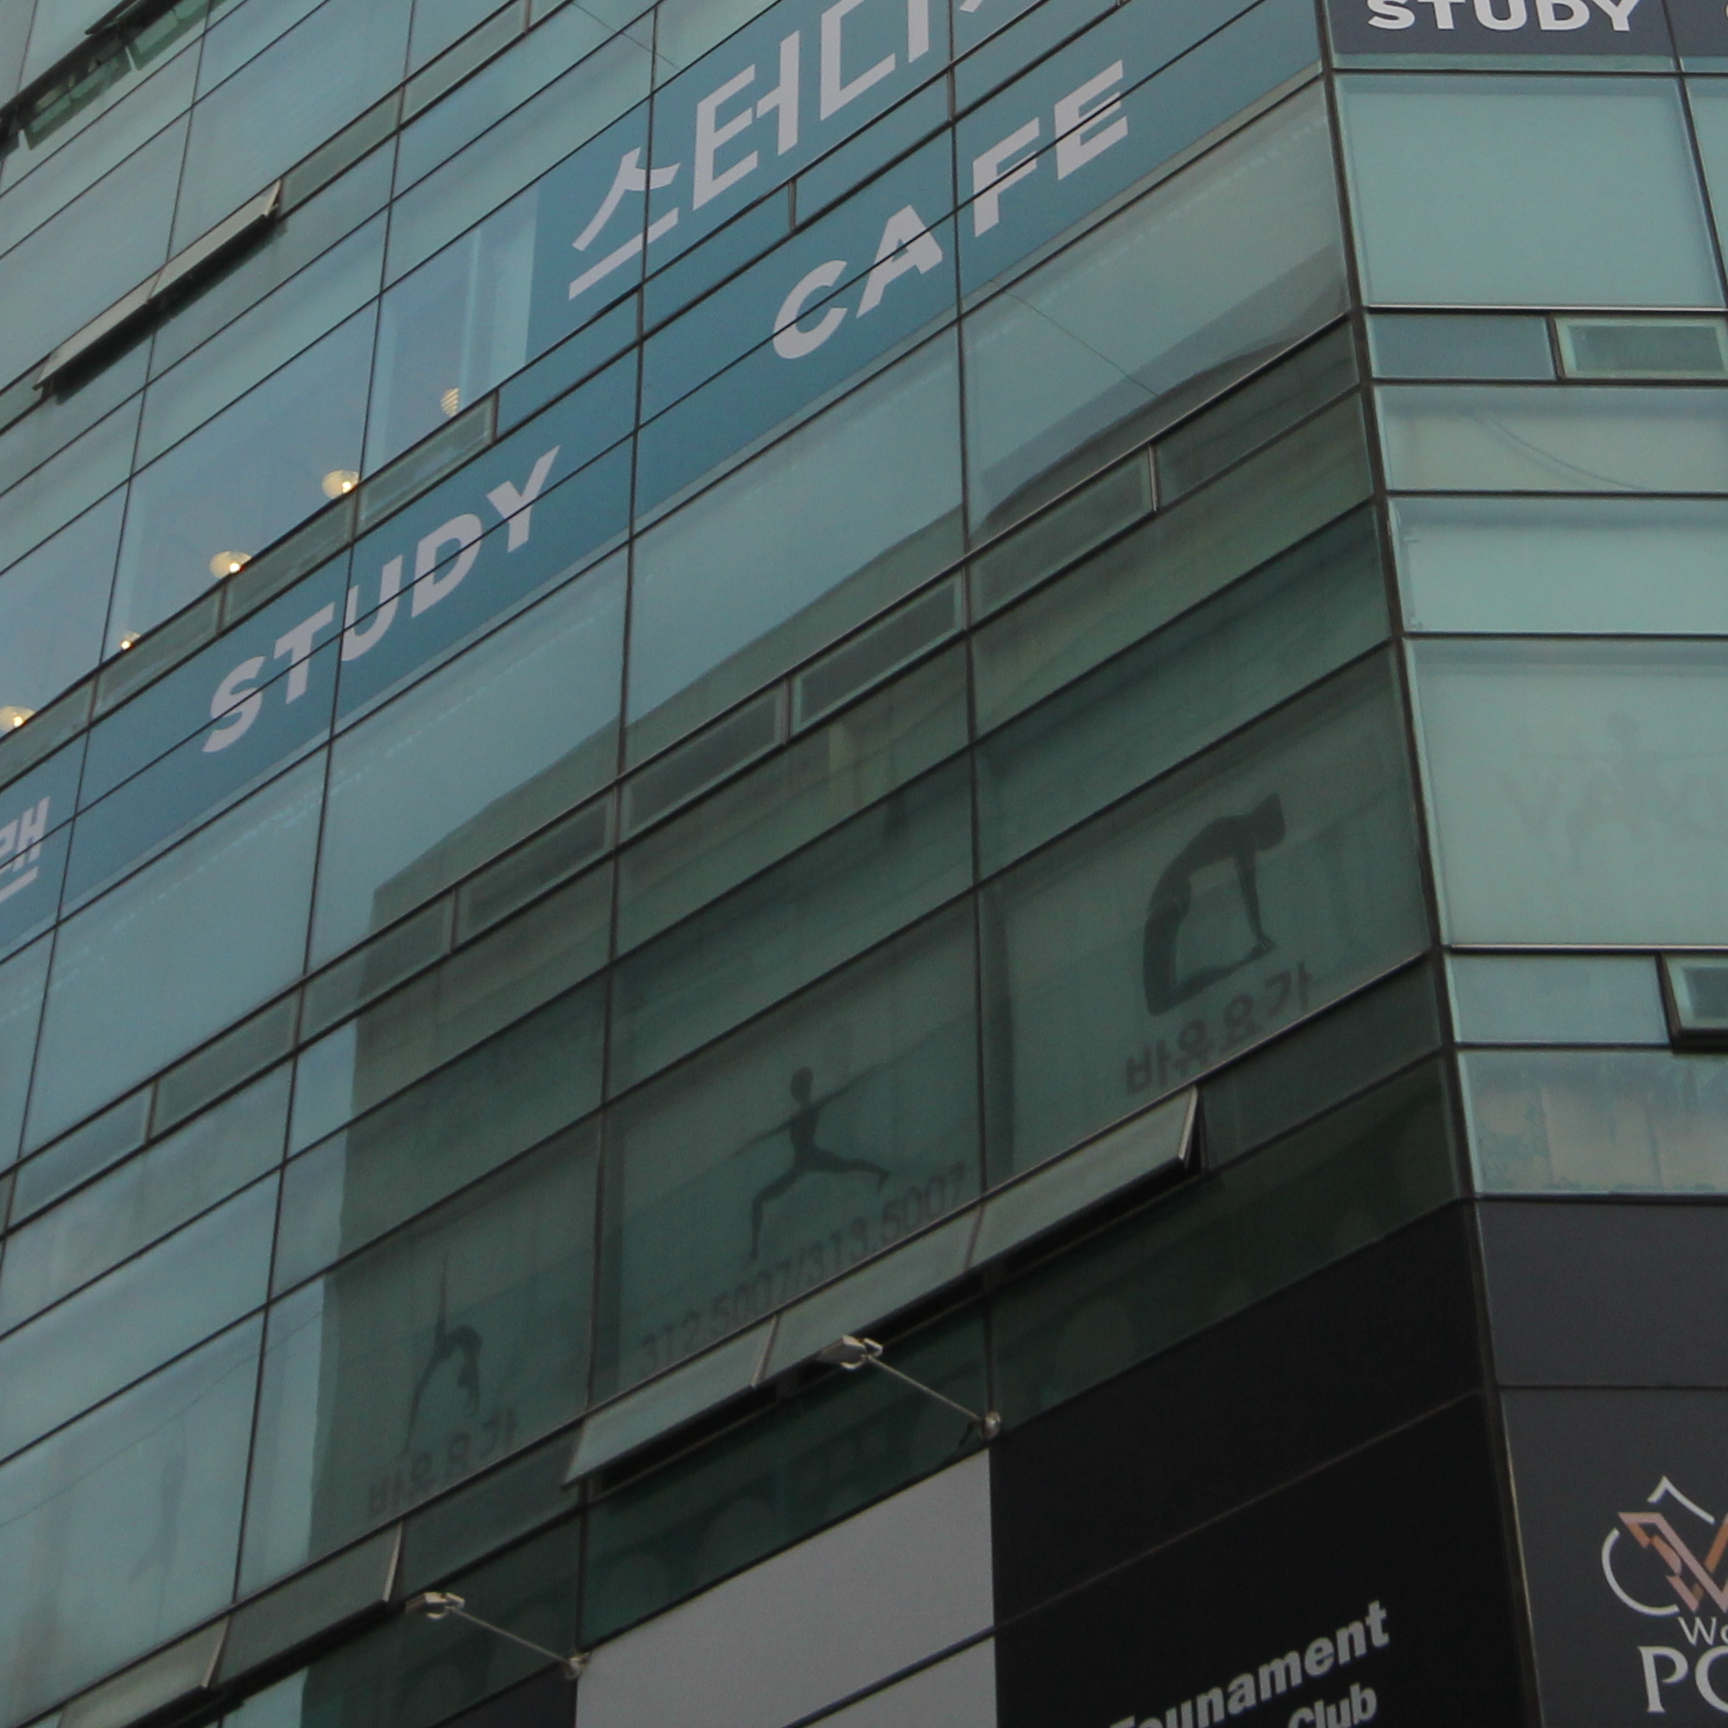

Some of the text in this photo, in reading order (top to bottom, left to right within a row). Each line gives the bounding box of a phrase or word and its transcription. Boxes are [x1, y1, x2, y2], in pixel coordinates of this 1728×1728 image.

[202, 60, 1129, 753] STUDY CAFE
[1110, 1600, 1390, 1728] unament
